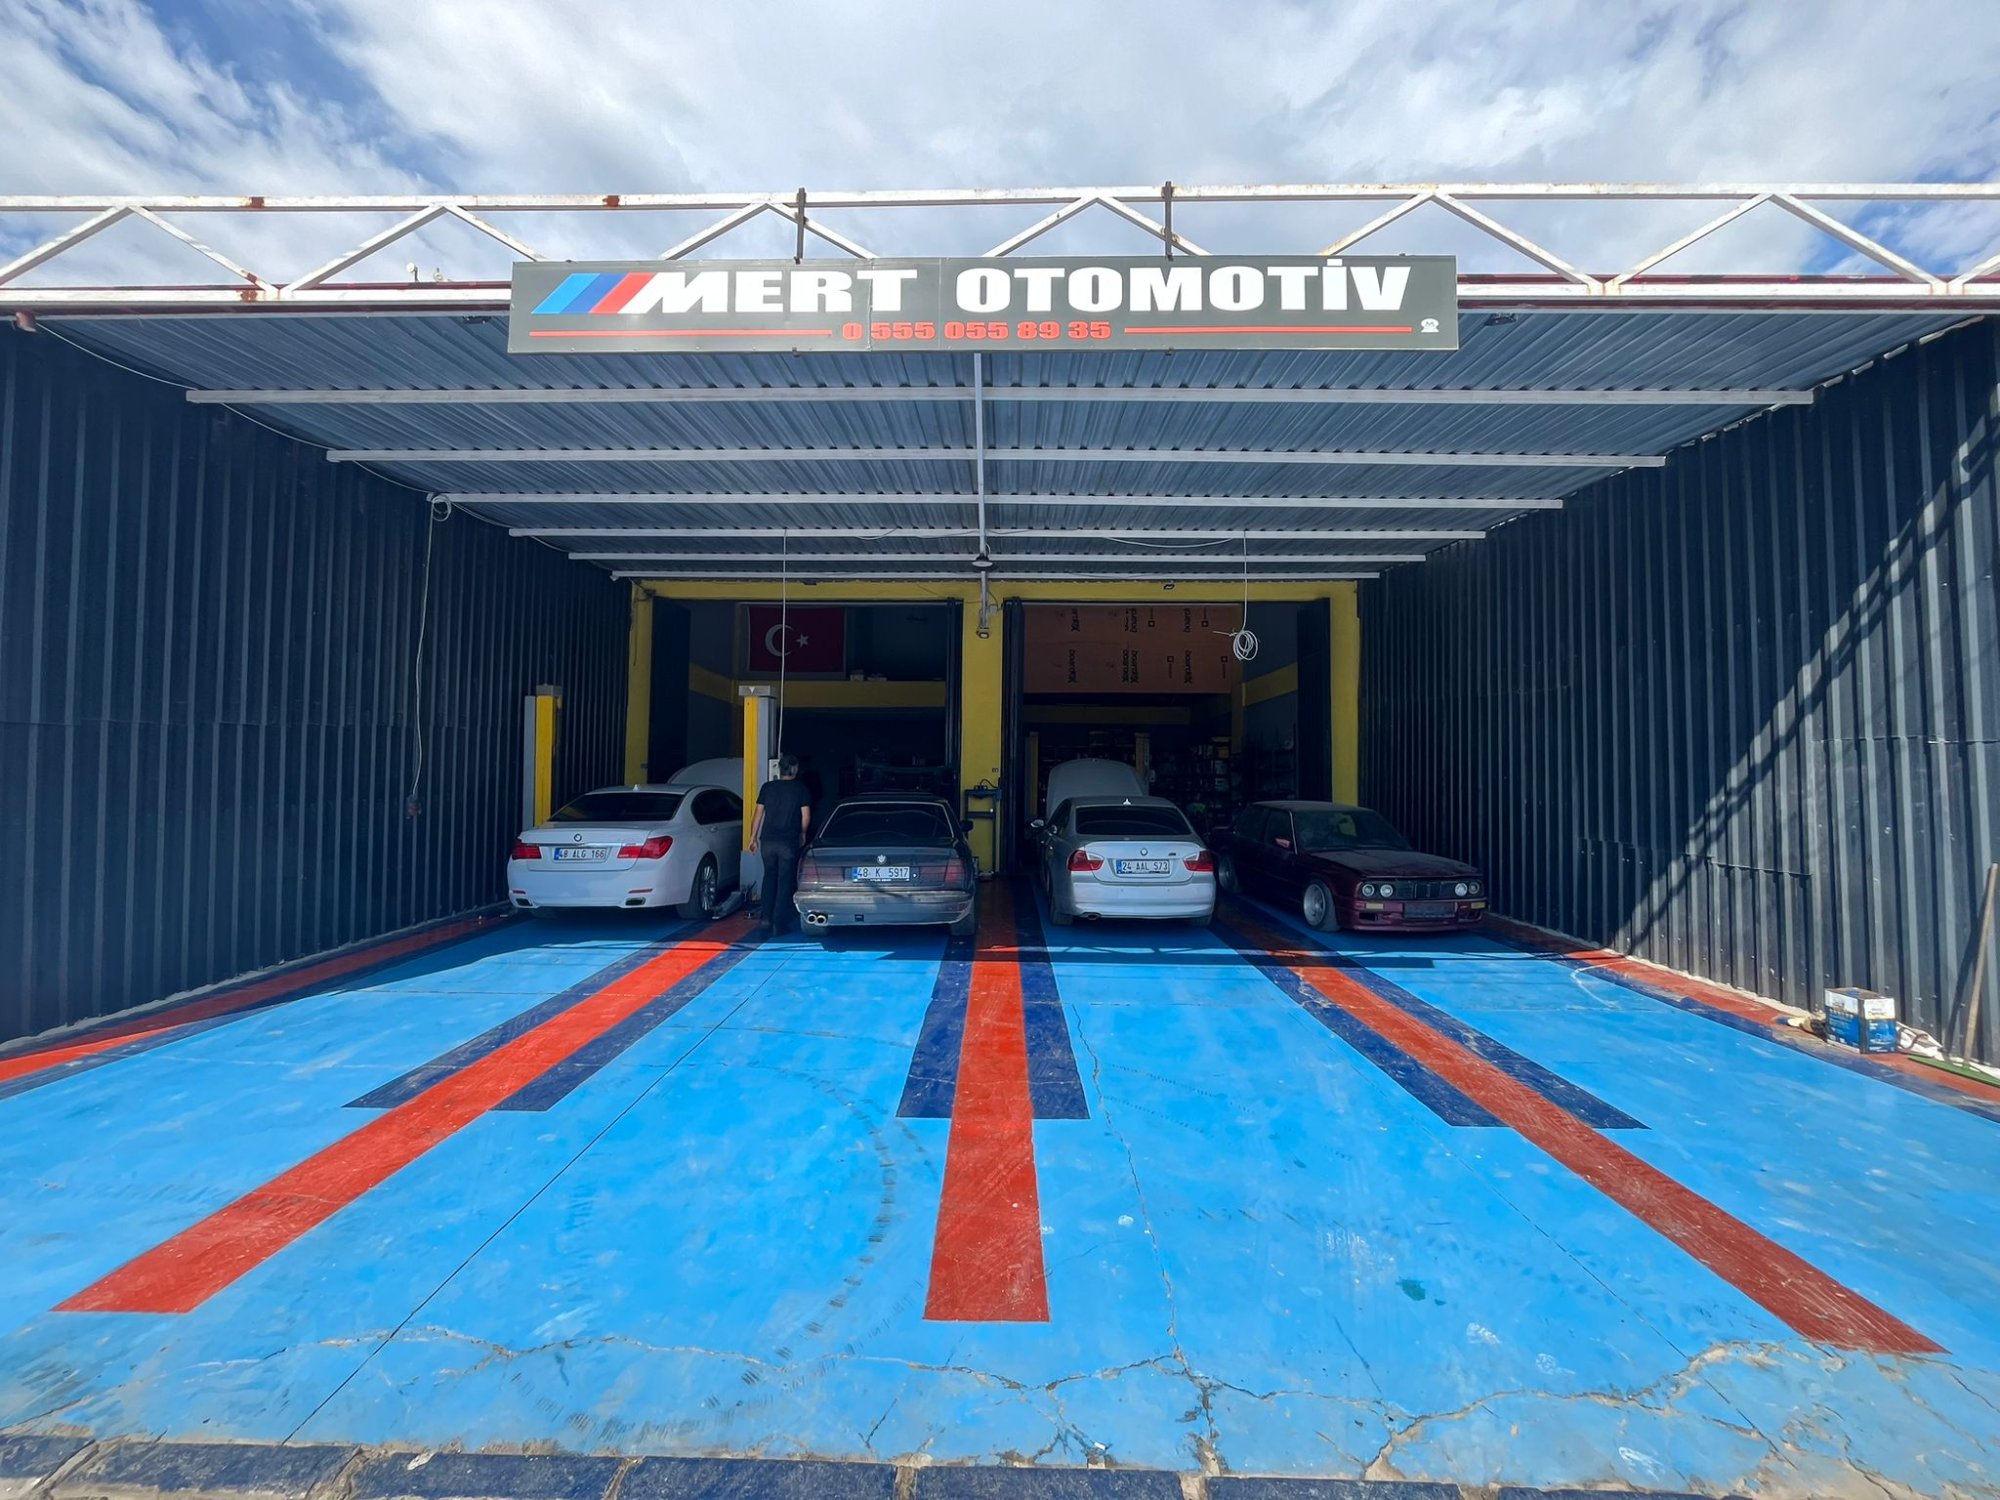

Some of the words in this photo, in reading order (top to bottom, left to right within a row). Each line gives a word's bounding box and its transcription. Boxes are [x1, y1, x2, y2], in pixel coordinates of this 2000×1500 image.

[617, 269, 918, 314] MERT
[955, 258, 1411, 312] OTOMOTİV
[842, 322, 863, 340] 0
[869, 322, 936, 340] 555
[943, 321, 1009, 339] 055
[1016, 321, 1060, 339] 89
[1067, 321, 1112, 339] 35
[572, 849, 587, 858] ALG
[1122, 861, 1132, 871] 24
[1136, 861, 1150, 871] AAL
[857, 867, 869, 877] 48
[875, 867, 880, 877] K
[888, 867, 908, 877] 5917
